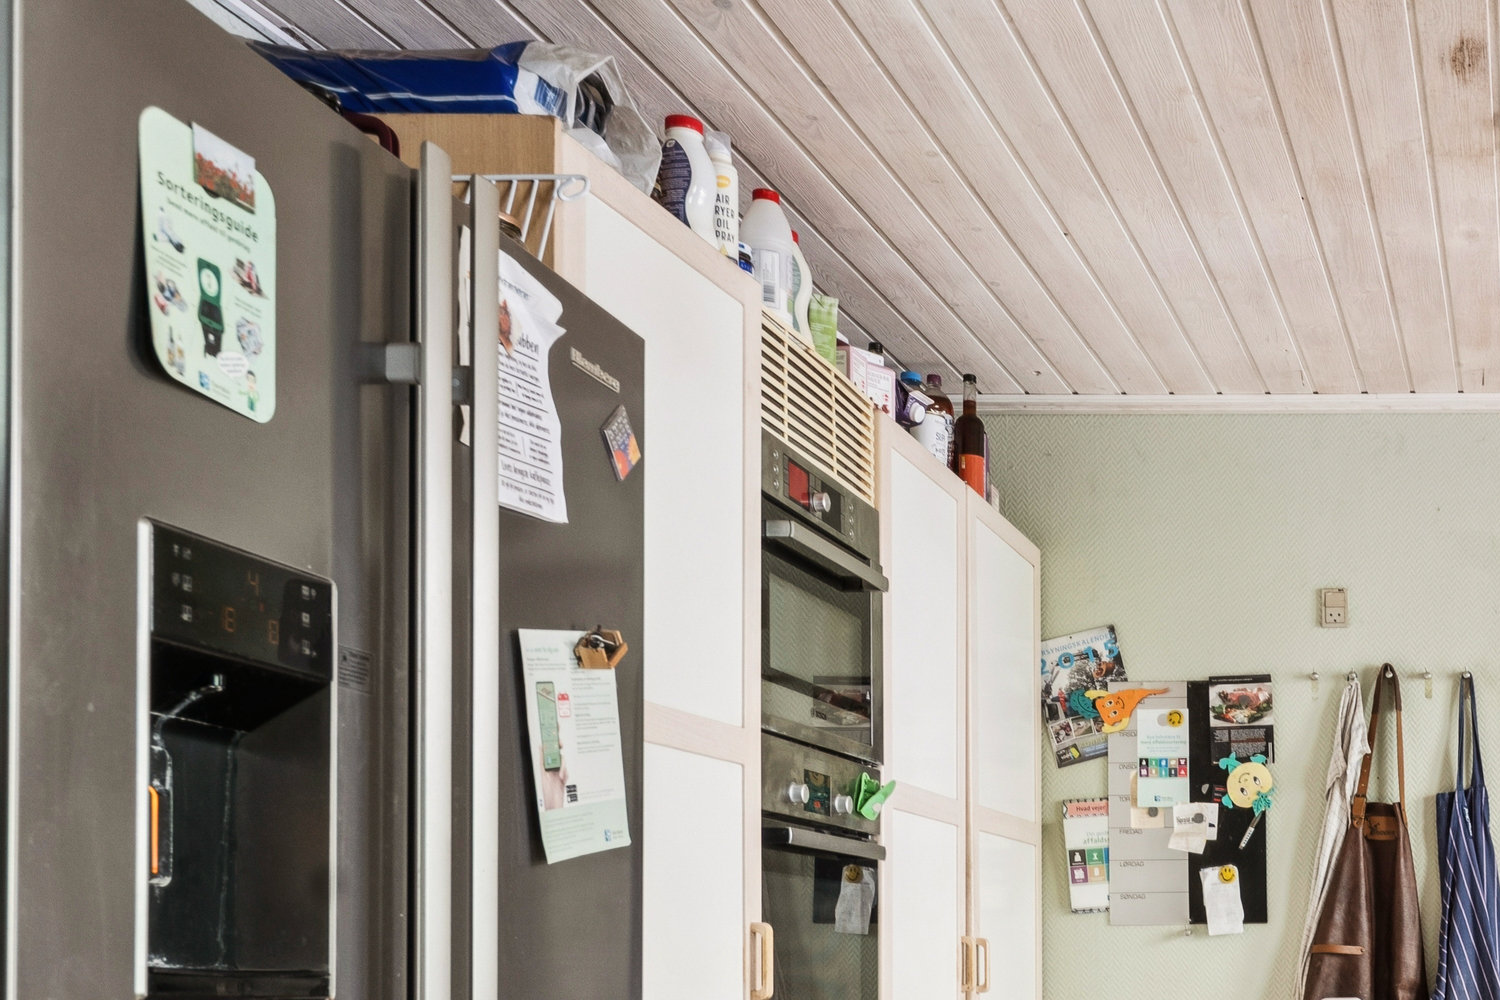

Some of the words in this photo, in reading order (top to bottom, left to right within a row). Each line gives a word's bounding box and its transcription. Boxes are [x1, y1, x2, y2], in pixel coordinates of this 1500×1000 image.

[157, 171, 259, 242] Sorteringsguide
[715, 193, 730, 205] AIR
[716, 218, 730, 230] OIL
[1041, 638, 1120, 676] 2015
